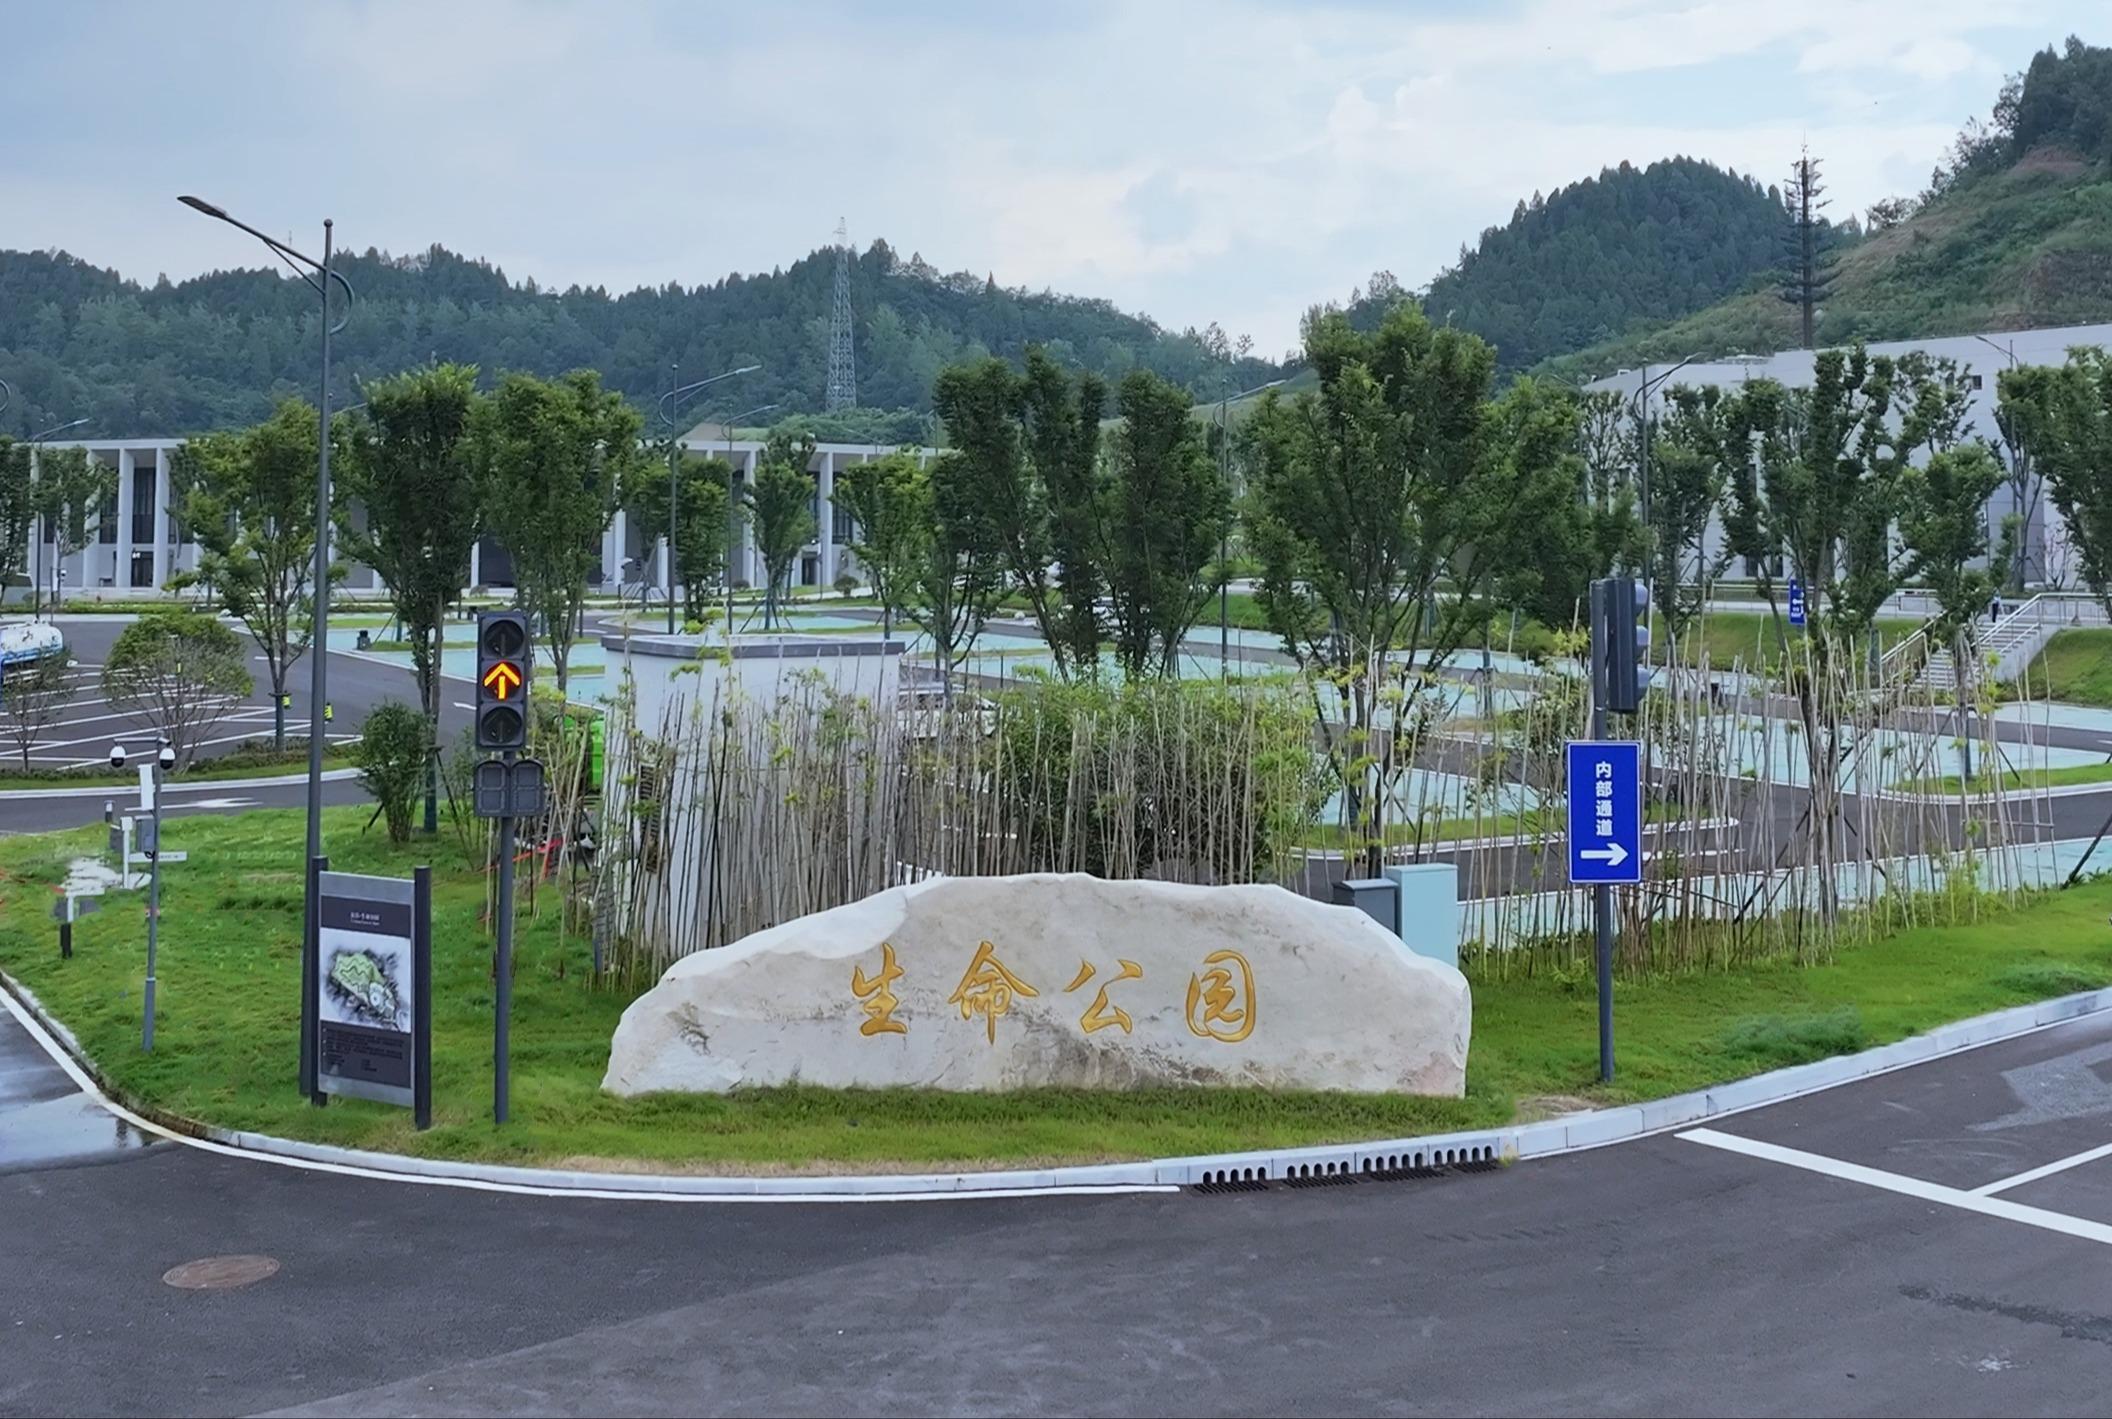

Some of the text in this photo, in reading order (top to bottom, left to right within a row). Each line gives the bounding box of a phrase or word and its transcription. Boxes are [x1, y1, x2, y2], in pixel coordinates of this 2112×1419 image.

[1595, 761, 1613, 836] 内部通道
[852, 940, 1256, 1046] 生命公园
